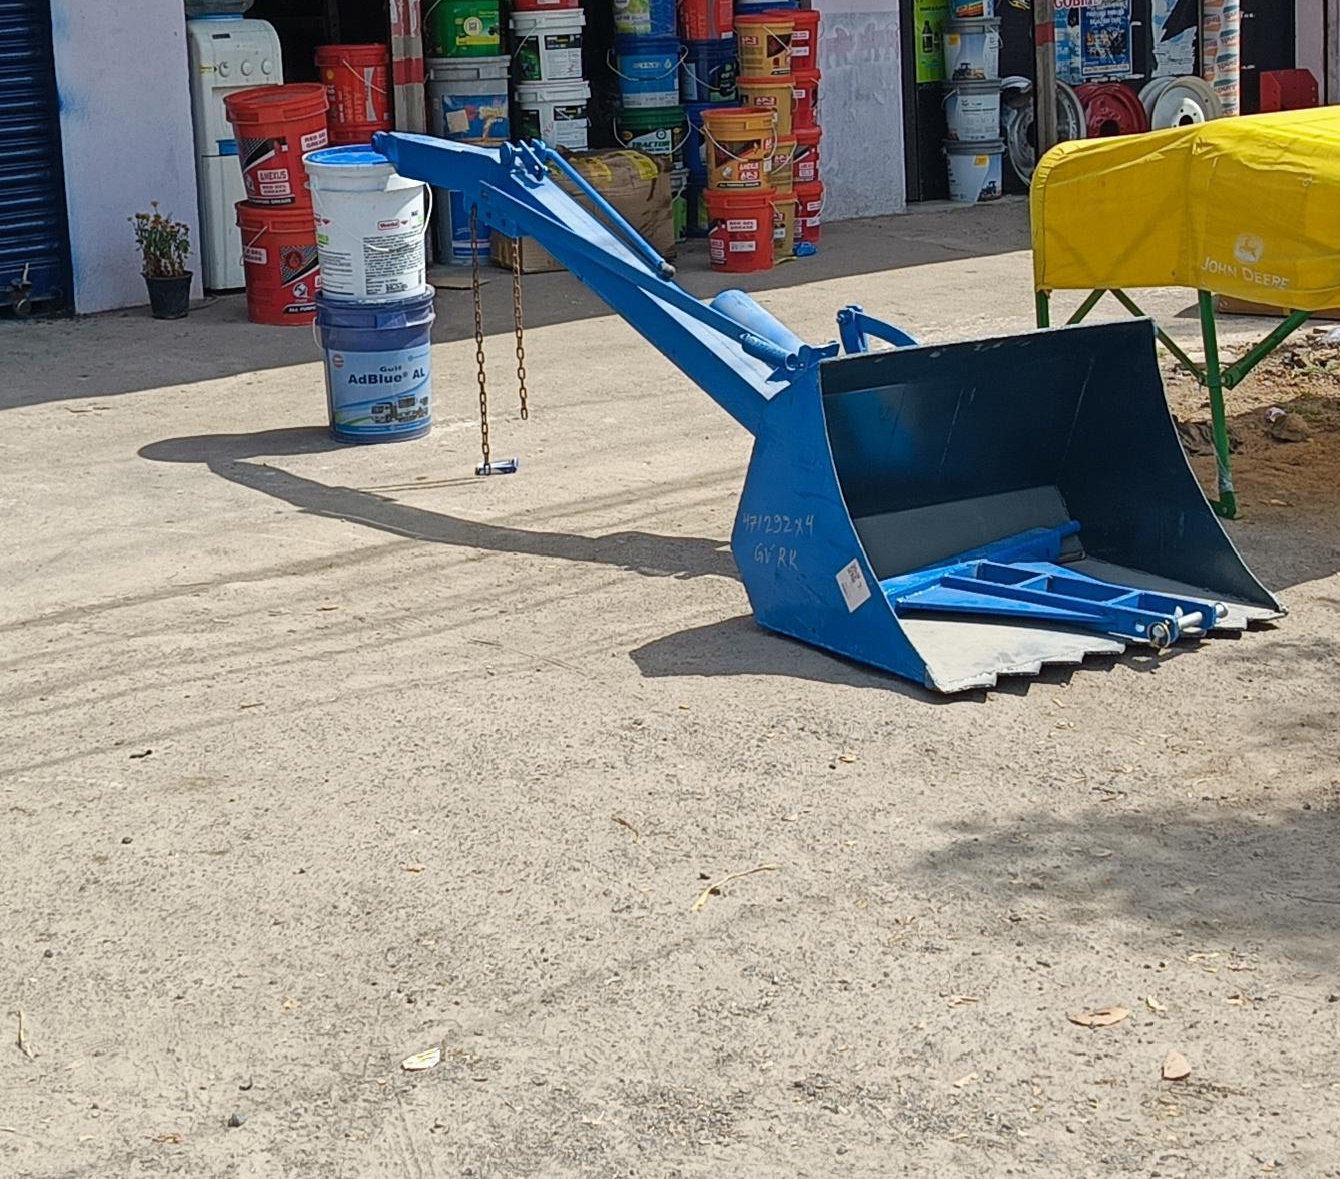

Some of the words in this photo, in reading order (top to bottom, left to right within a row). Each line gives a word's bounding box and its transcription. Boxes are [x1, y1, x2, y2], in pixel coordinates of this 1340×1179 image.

[1201, 256, 1238, 277] JOHN
[1242, 266, 1290, 290] DEERE
[412, 367, 426, 380] AL
